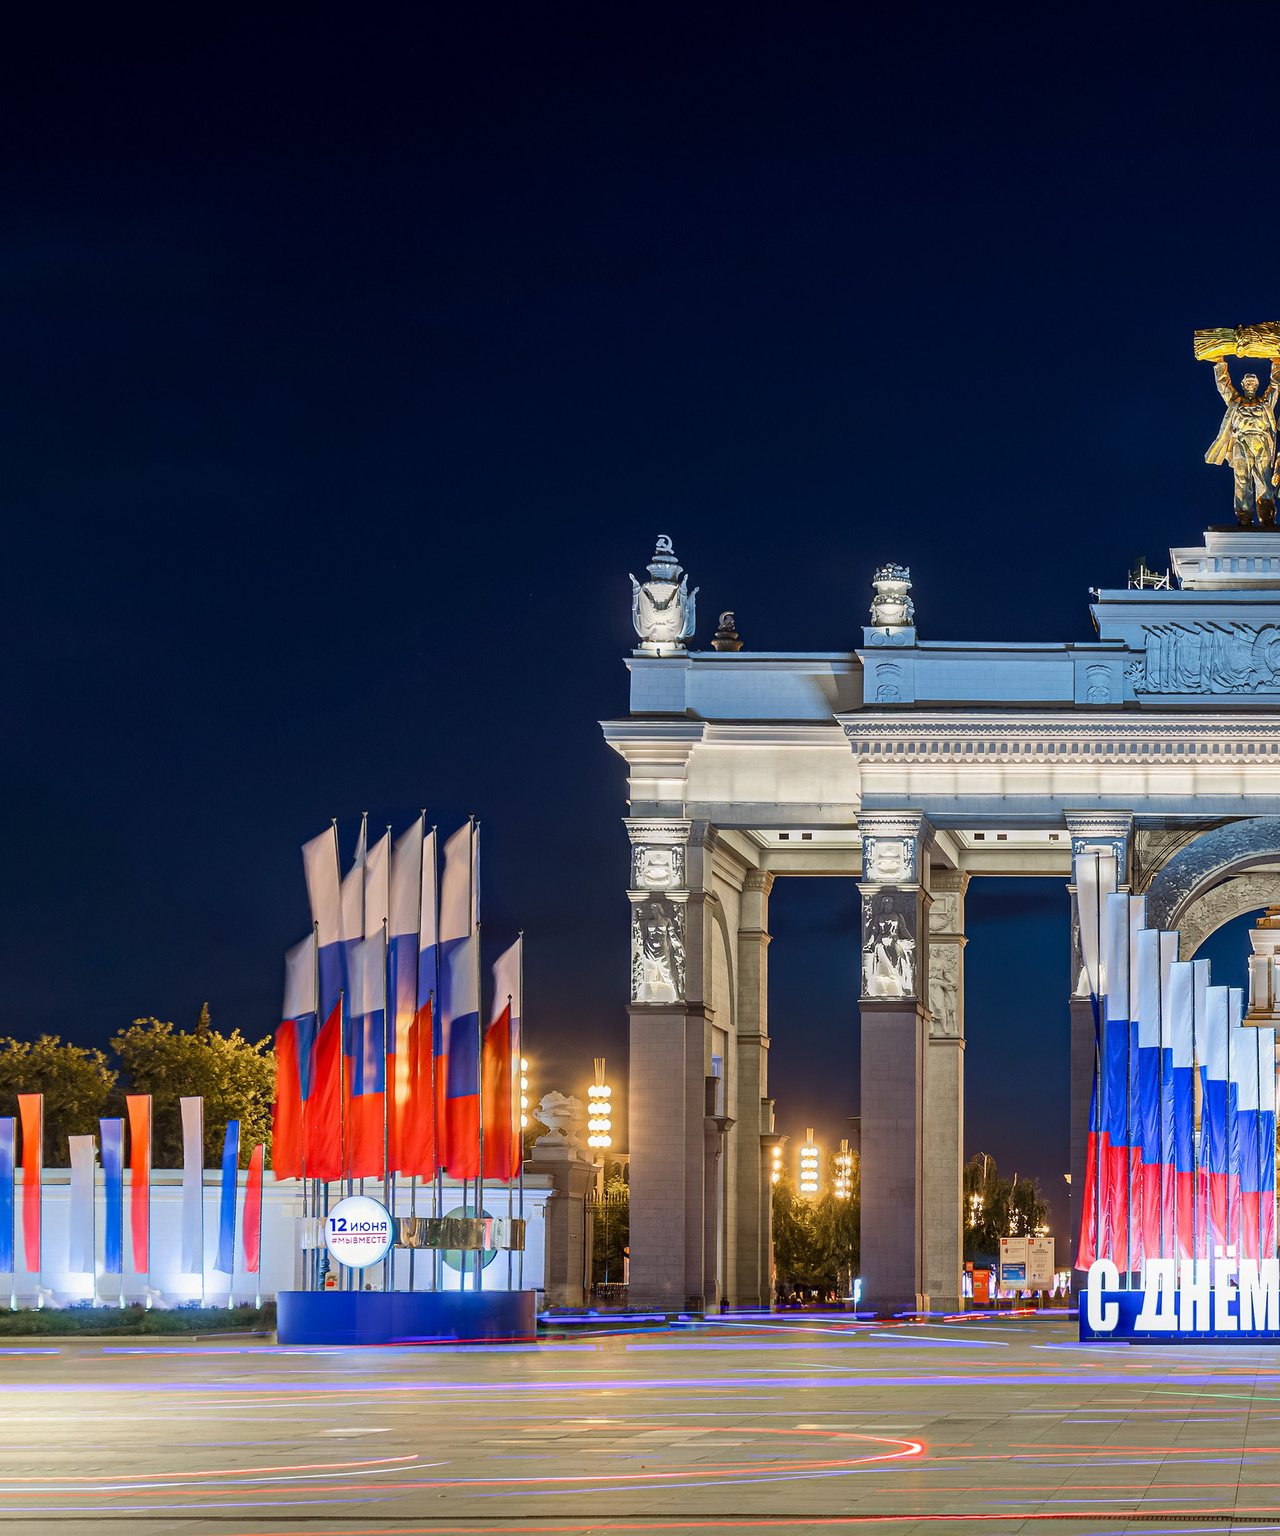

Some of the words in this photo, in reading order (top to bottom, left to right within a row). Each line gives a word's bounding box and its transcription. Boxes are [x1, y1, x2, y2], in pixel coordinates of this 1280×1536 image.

[330, 1218, 347, 1232] 12
[350, 1222, 387, 1232] ИЮНЯ
[332, 1236, 387, 1244] #МЫВМЕСТЕ
[1087, 1258, 1120, 1331] С
[1134, 1245, 1280, 1331] ДНЁМ
